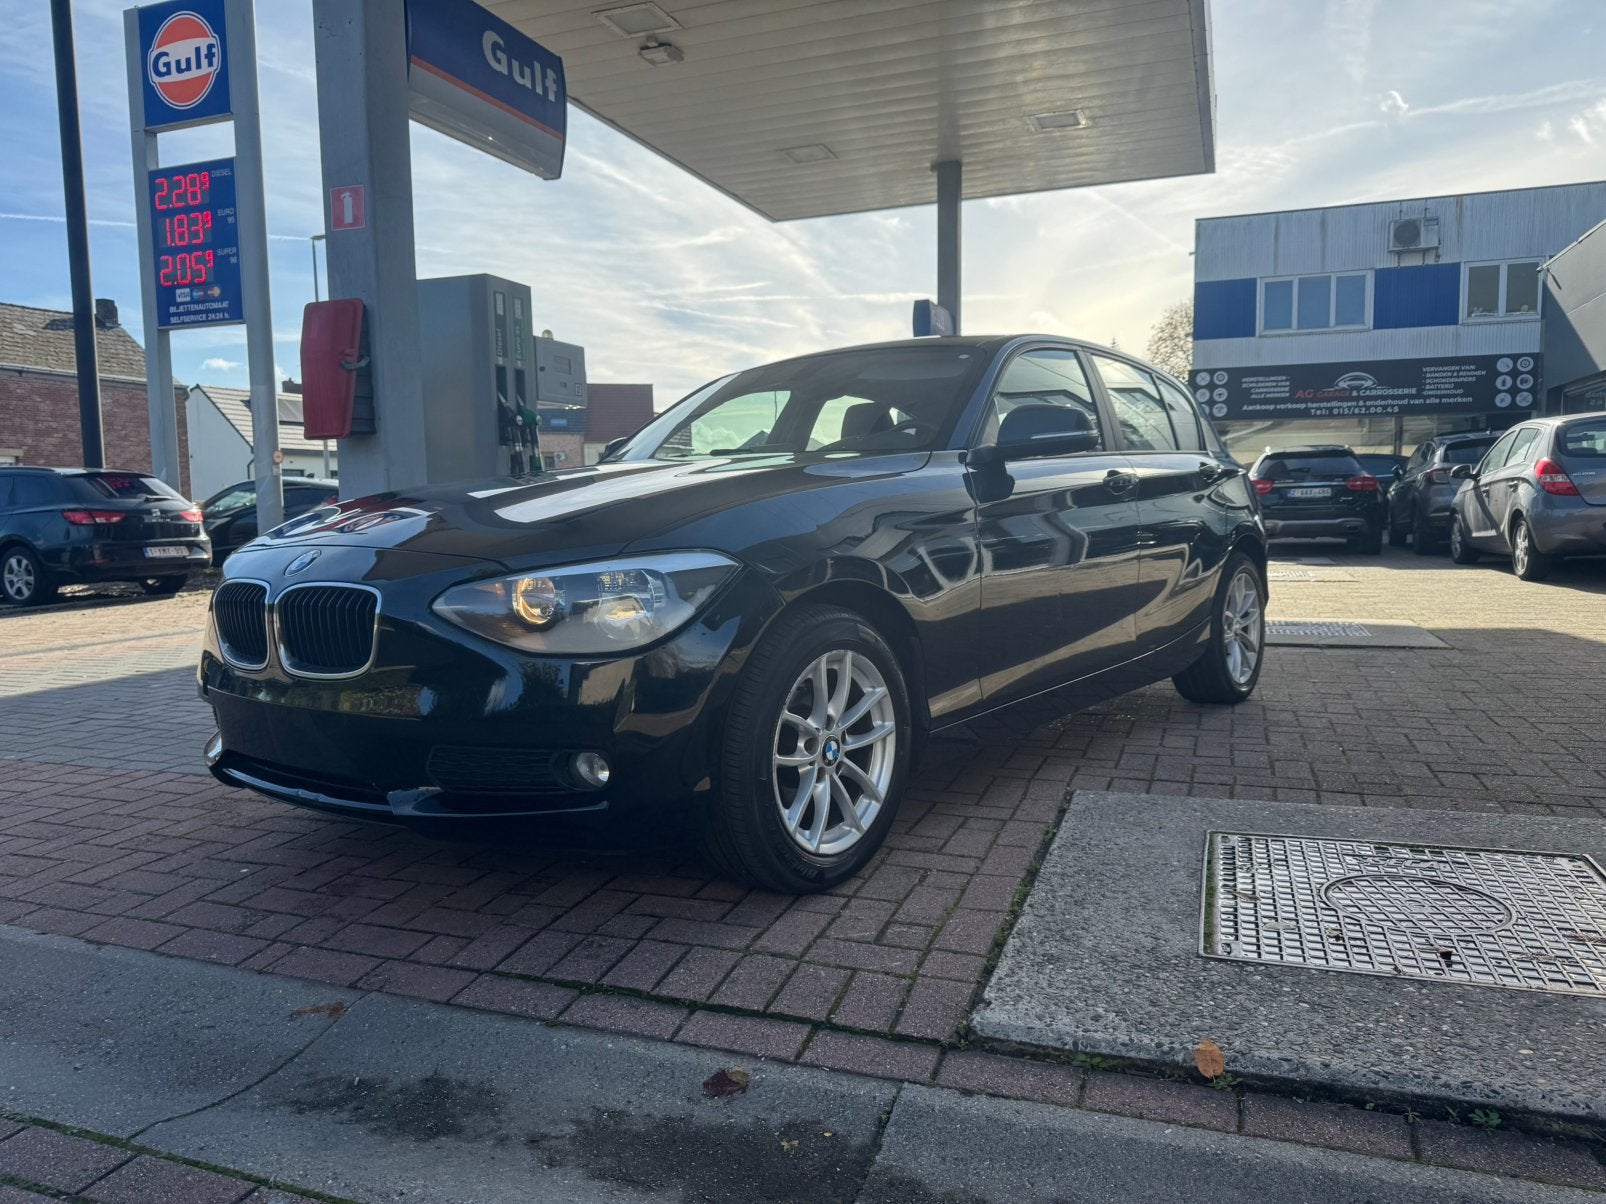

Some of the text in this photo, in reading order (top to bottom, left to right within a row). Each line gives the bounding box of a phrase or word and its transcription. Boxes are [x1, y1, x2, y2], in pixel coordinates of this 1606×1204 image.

[152, 43, 216, 78] Gulf
[482, 30, 557, 103] Gulf
[211, 168, 232, 177] DIESEL
[217, 208, 235, 216] EURO
[216, 247, 237, 256] SUPER
[170, 314, 207, 324] SELFSERVICE
[1295, 389, 1314, 398] AG
[1360, 387, 1417, 396] CARROSSERIE
[1307, 400, 1357, 408] herstellingen
